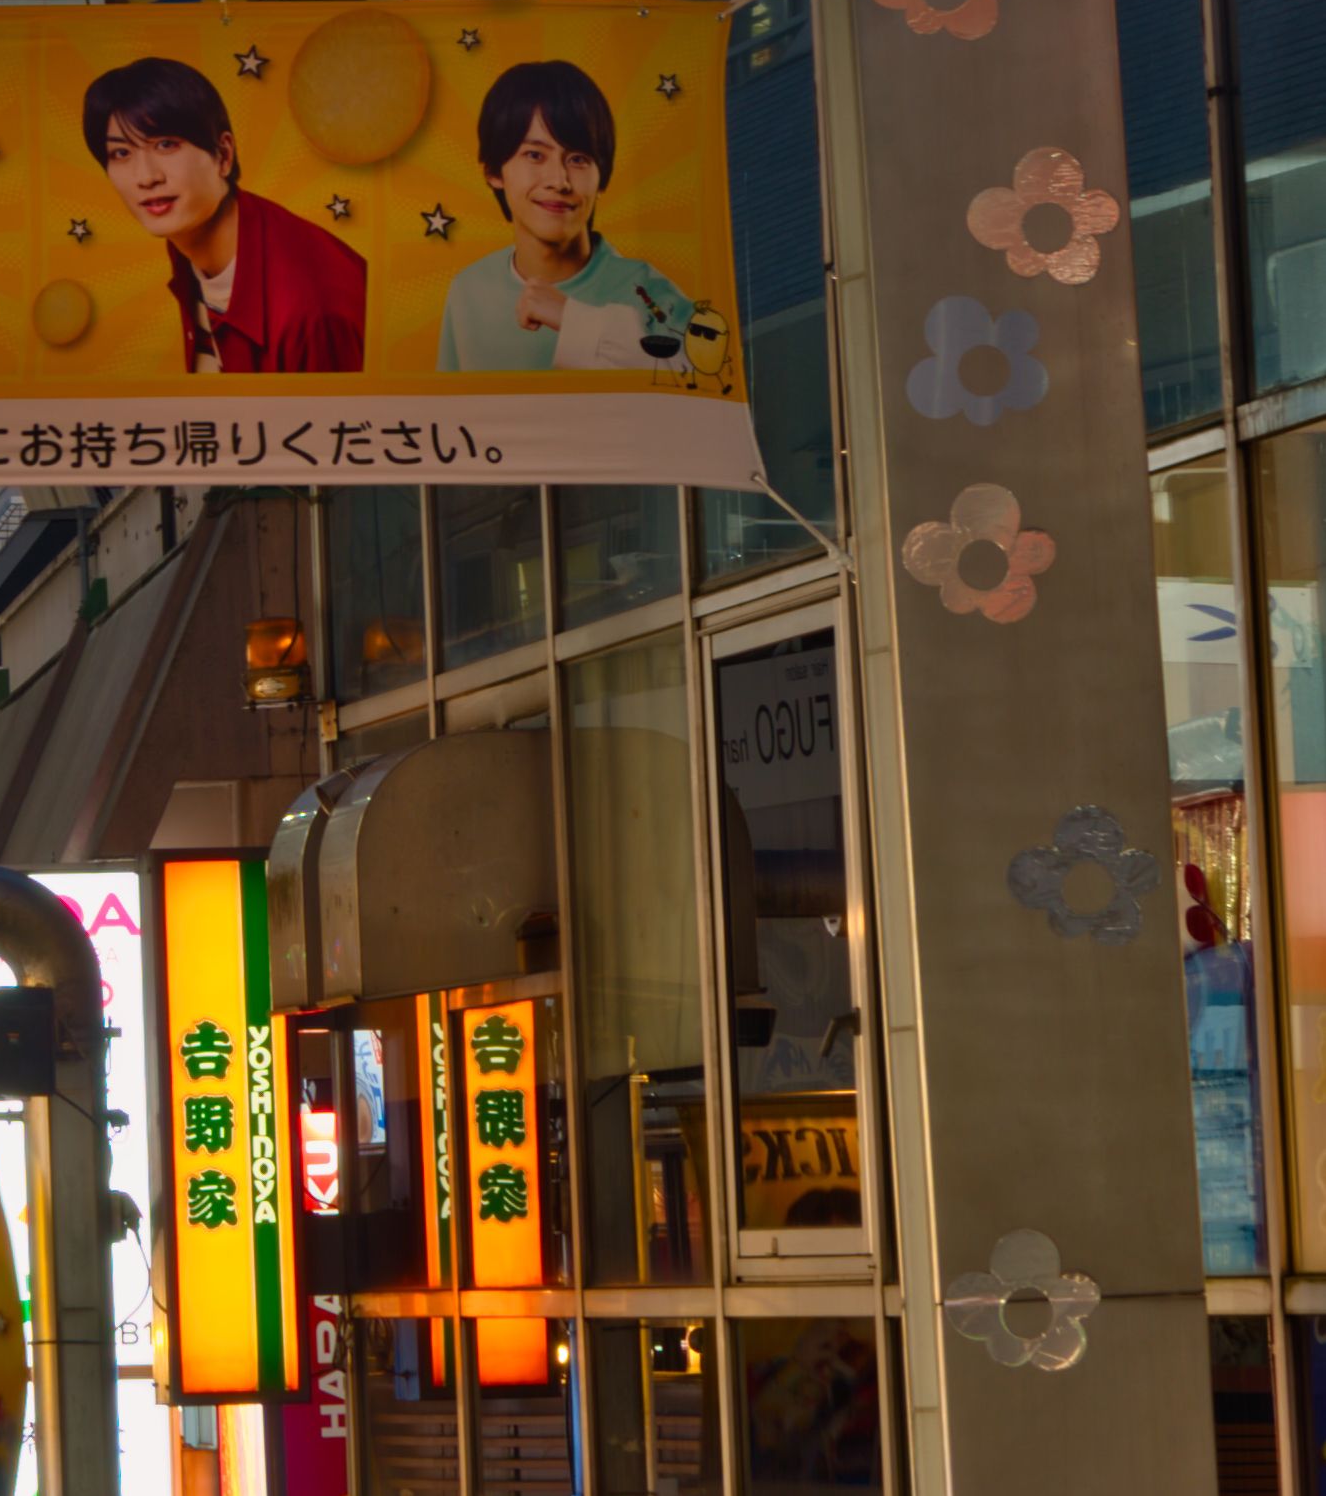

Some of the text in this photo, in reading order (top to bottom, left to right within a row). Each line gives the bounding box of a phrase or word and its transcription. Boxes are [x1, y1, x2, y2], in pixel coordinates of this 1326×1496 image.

[180, 1019, 239, 1230] 吉野家
[248, 1025, 277, 1224] YOSHINOYA
